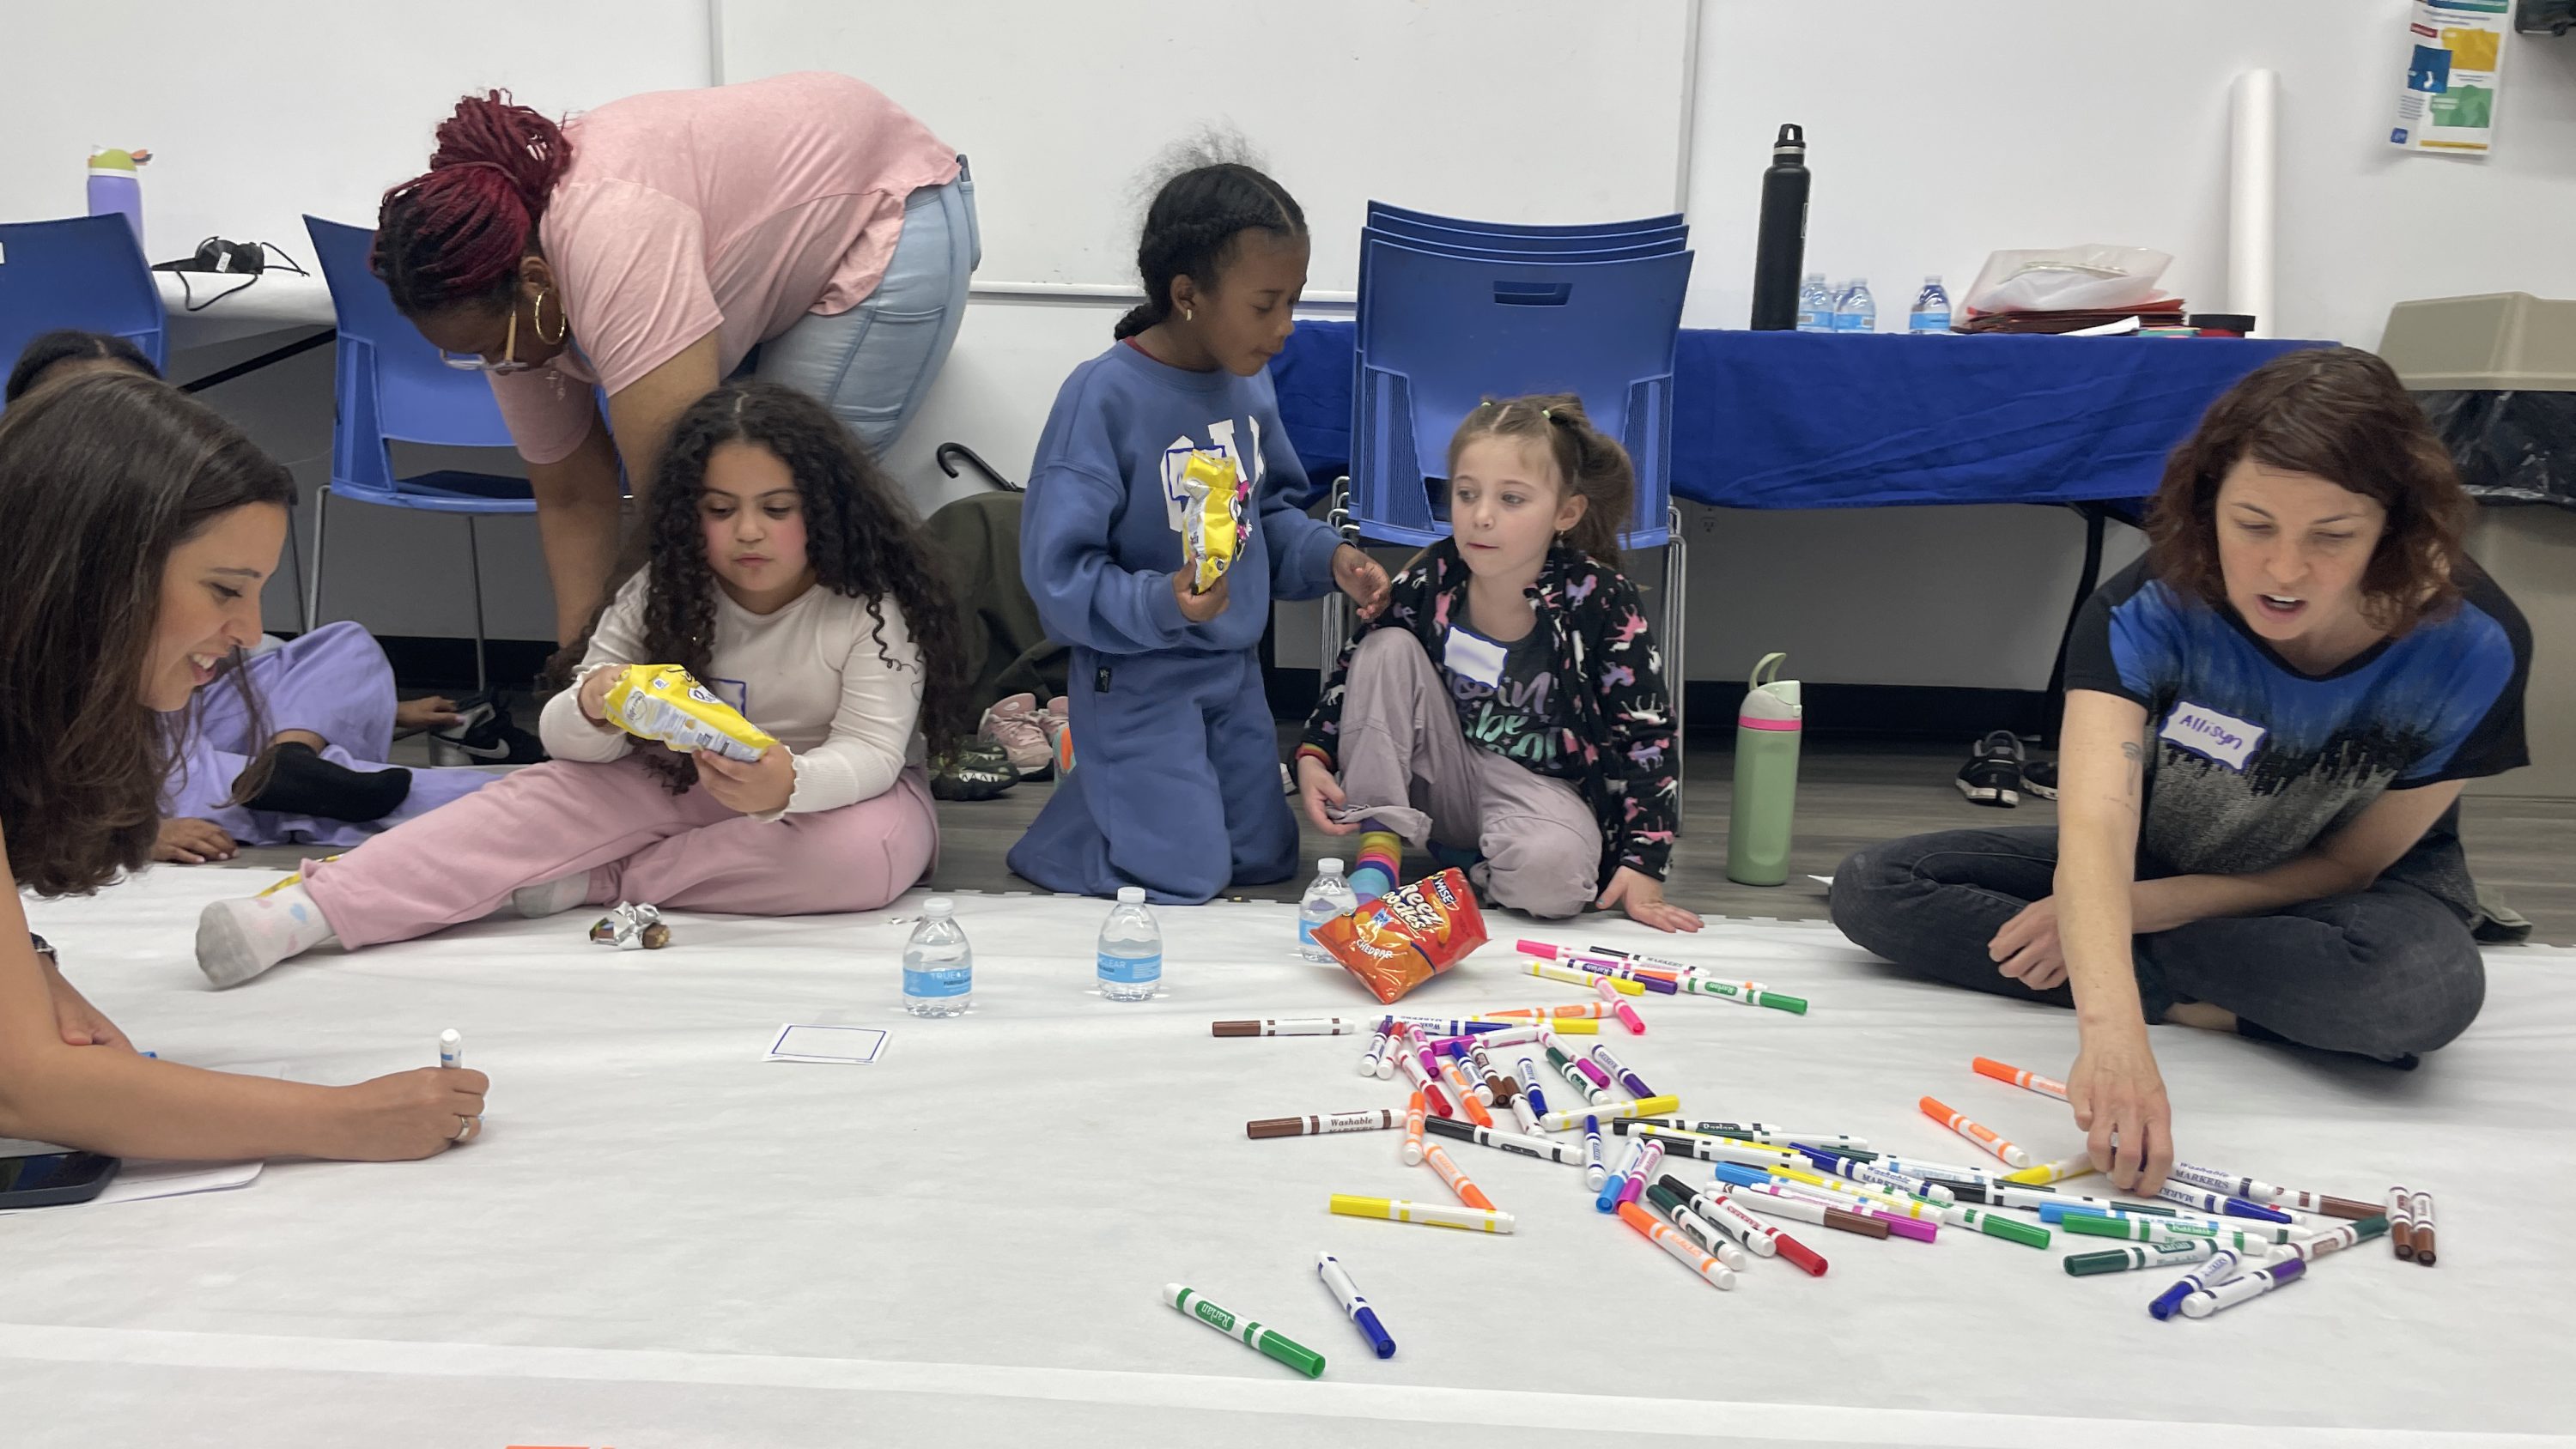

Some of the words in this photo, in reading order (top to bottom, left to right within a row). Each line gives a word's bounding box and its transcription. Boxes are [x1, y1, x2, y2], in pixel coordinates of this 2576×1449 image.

[1397, 881, 1445, 925] heez
[1434, 878, 1454, 906] WISE
[1382, 891, 1426, 929] oodles
[1357, 939, 1394, 959] CHEDDAR
[1330, 1117, 1374, 1127] Washable
[2175, 1169, 2230, 1191] MARKERS
[2180, 1162, 2229, 1178] Washable
[2160, 1187, 2195, 1203] MARK
[1201, 1303, 1232, 1328] Rarlan
